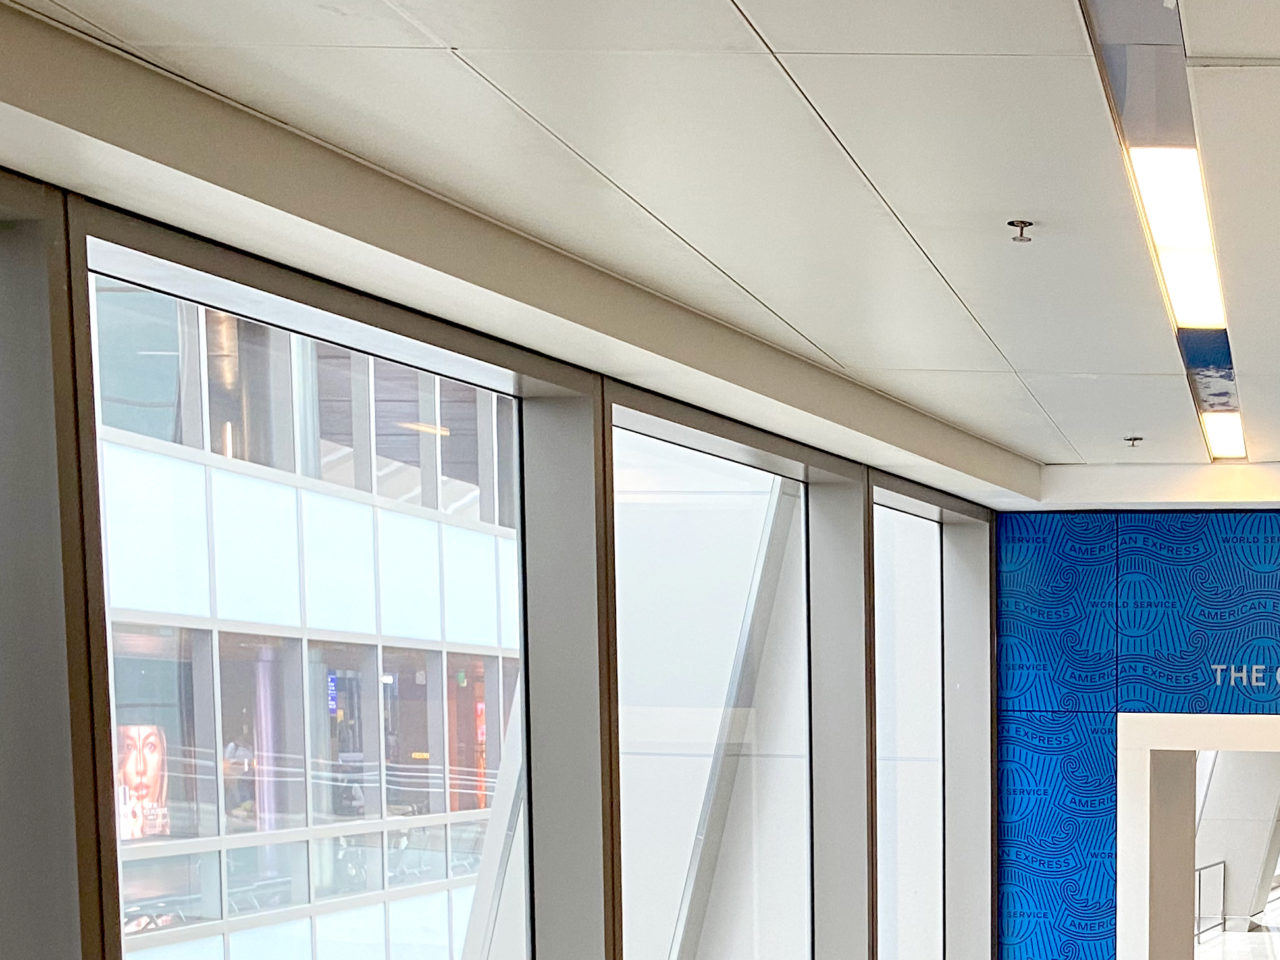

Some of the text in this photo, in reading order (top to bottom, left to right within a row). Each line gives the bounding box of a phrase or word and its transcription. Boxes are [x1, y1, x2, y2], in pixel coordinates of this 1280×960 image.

[1005, 535, 1049, 545] SERVICE
[1069, 535, 1200, 557] AMERICAN EXPRESS
[1220, 535, 1260, 544] WORLD
[1014, 600, 1071, 620] EXPRESS
[1089, 600, 1178, 609] WORLD SERVICE
[1198, 600, 1267, 621] AMERICAN
[1005, 663, 1049, 672] SERVICE
[1068, 664, 1138, 684] AMERICAN
[1142, 665, 1200, 685] EXPRESS
[1211, 664, 1266, 687] THE
[1015, 726, 1071, 746] EXPRESS
[1006, 788, 1049, 797] SERVICE
[1015, 850, 1071, 869] EXPRESS
[1006, 911, 1049, 919] SERVICE
